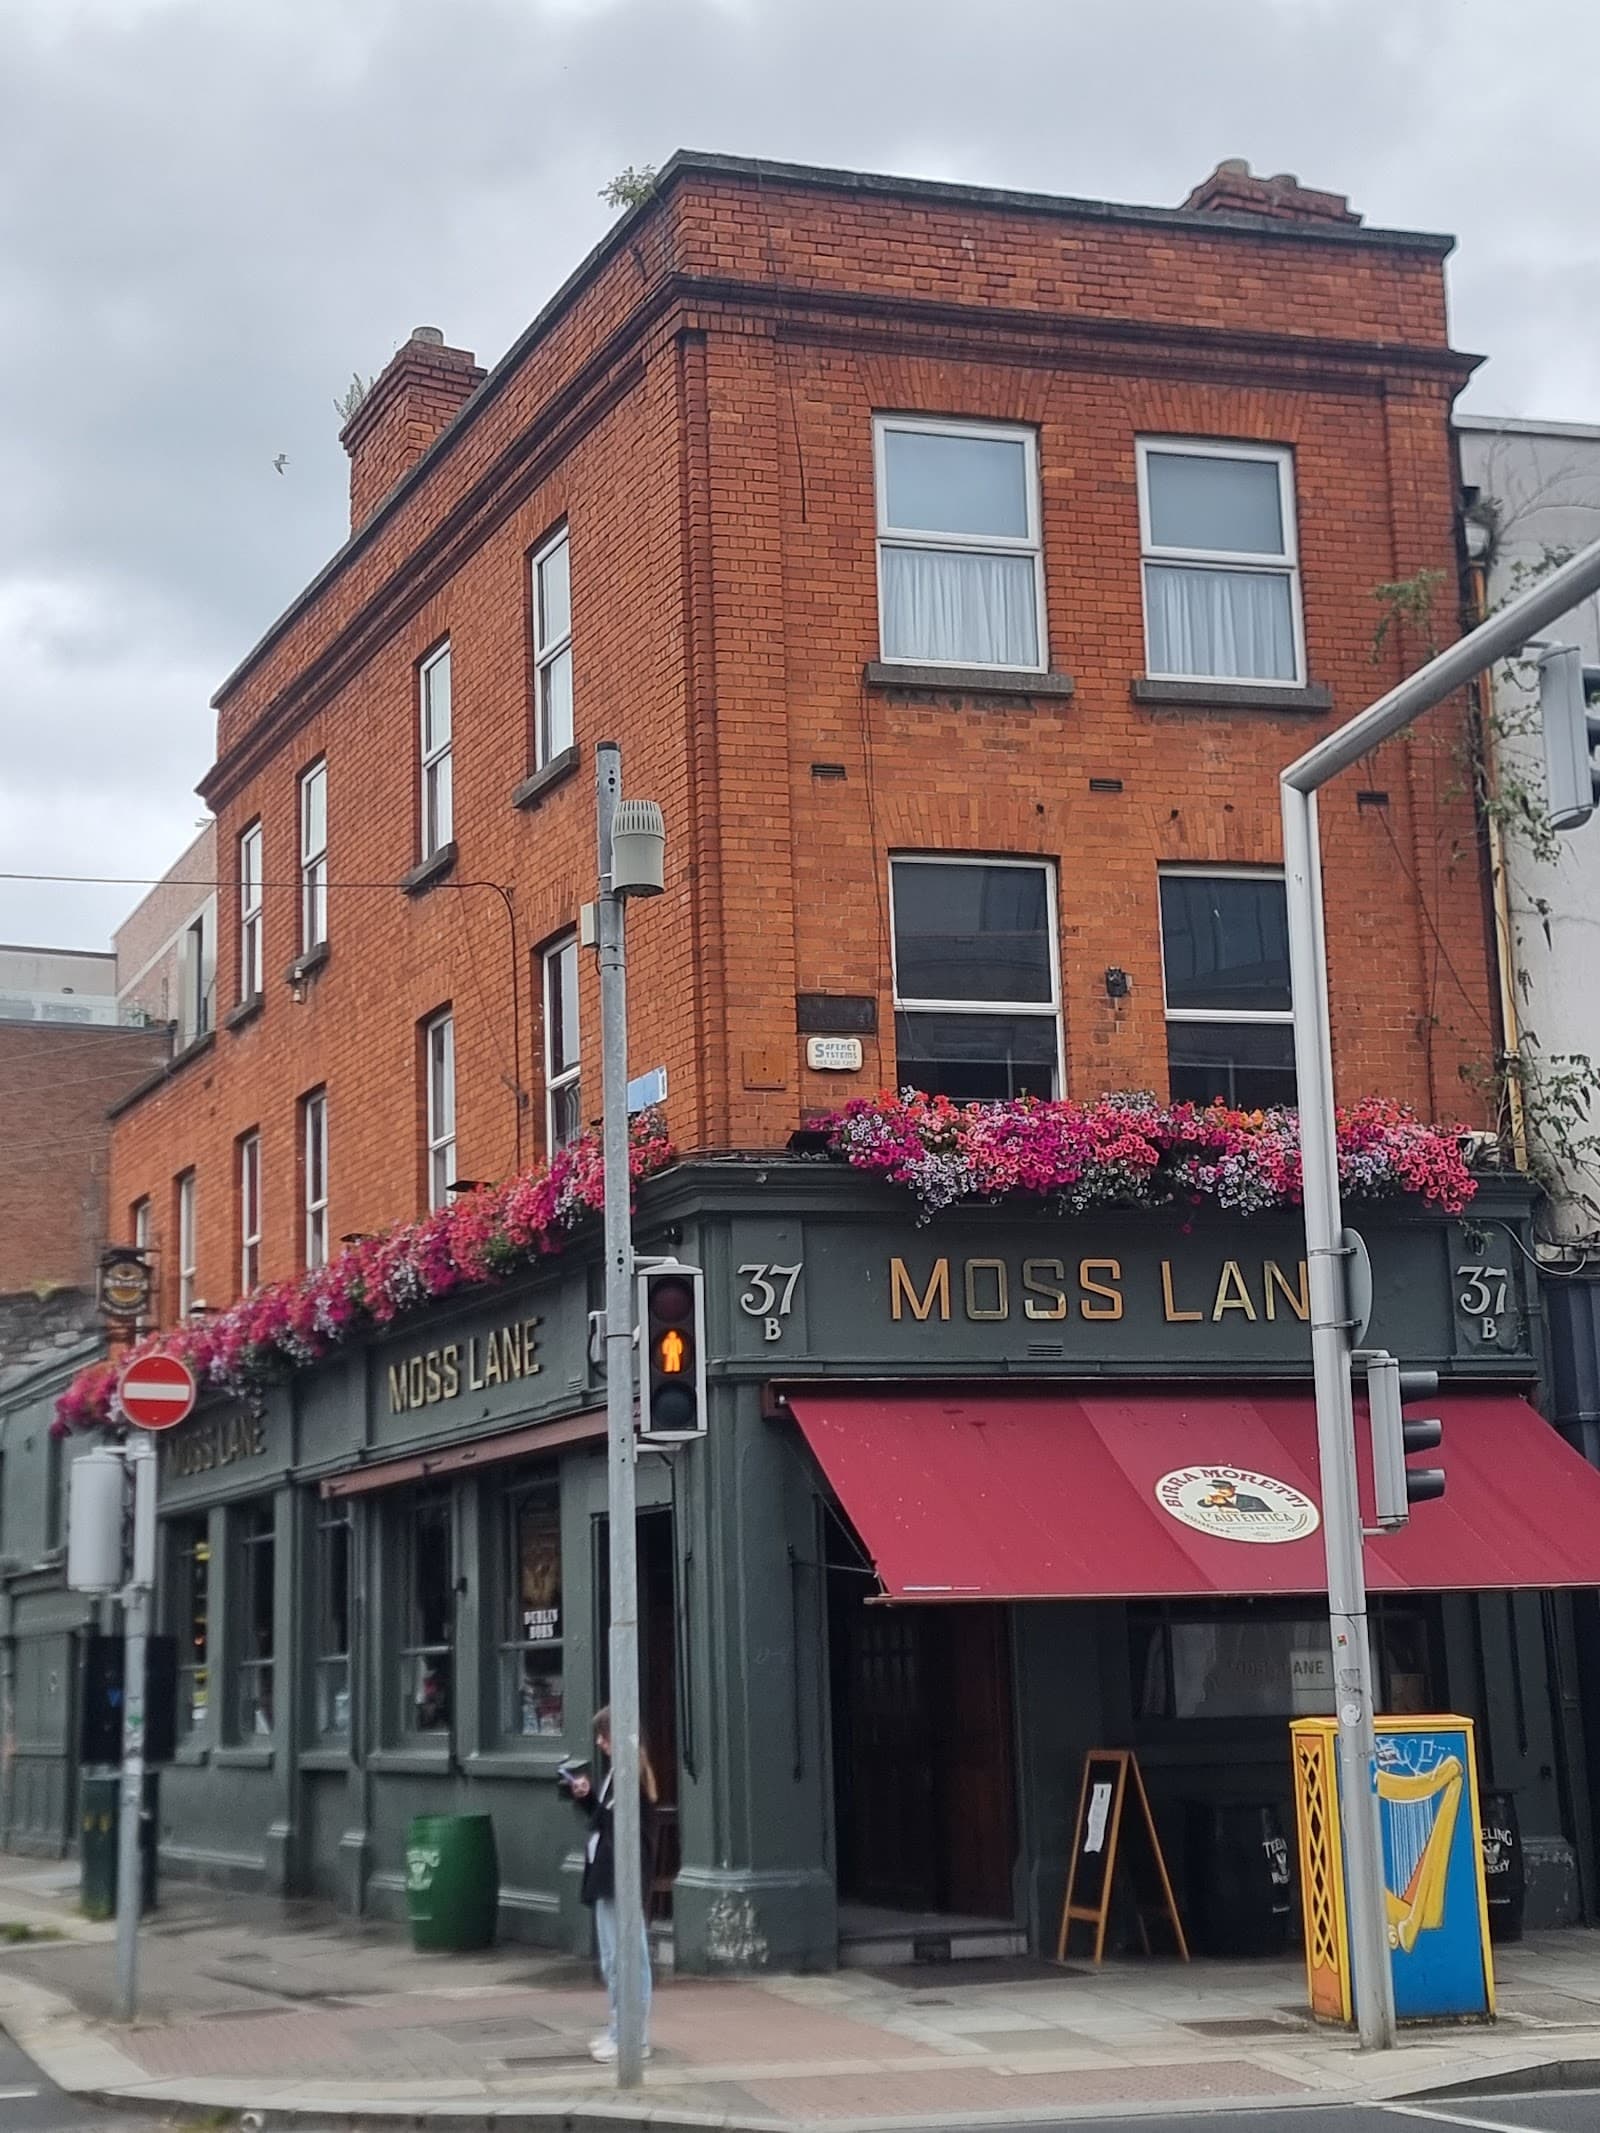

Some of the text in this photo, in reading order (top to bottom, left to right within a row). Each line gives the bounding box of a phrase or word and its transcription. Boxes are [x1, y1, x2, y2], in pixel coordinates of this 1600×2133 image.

[737, 1262, 803, 1316] 37
[890, 1257, 1310, 1321] MOSS LAN
[1456, 1265, 1508, 1315] 37
[764, 1317, 782, 1341] B
[1481, 1317, 1497, 1339] B
[388, 1317, 541, 1414] MOSS LANE
[1163, 1468, 1310, 1509] BIRRA MORETTI
[1293, 1658, 1326, 1676] ANE
[1480, 1828, 1513, 1846] ELING
